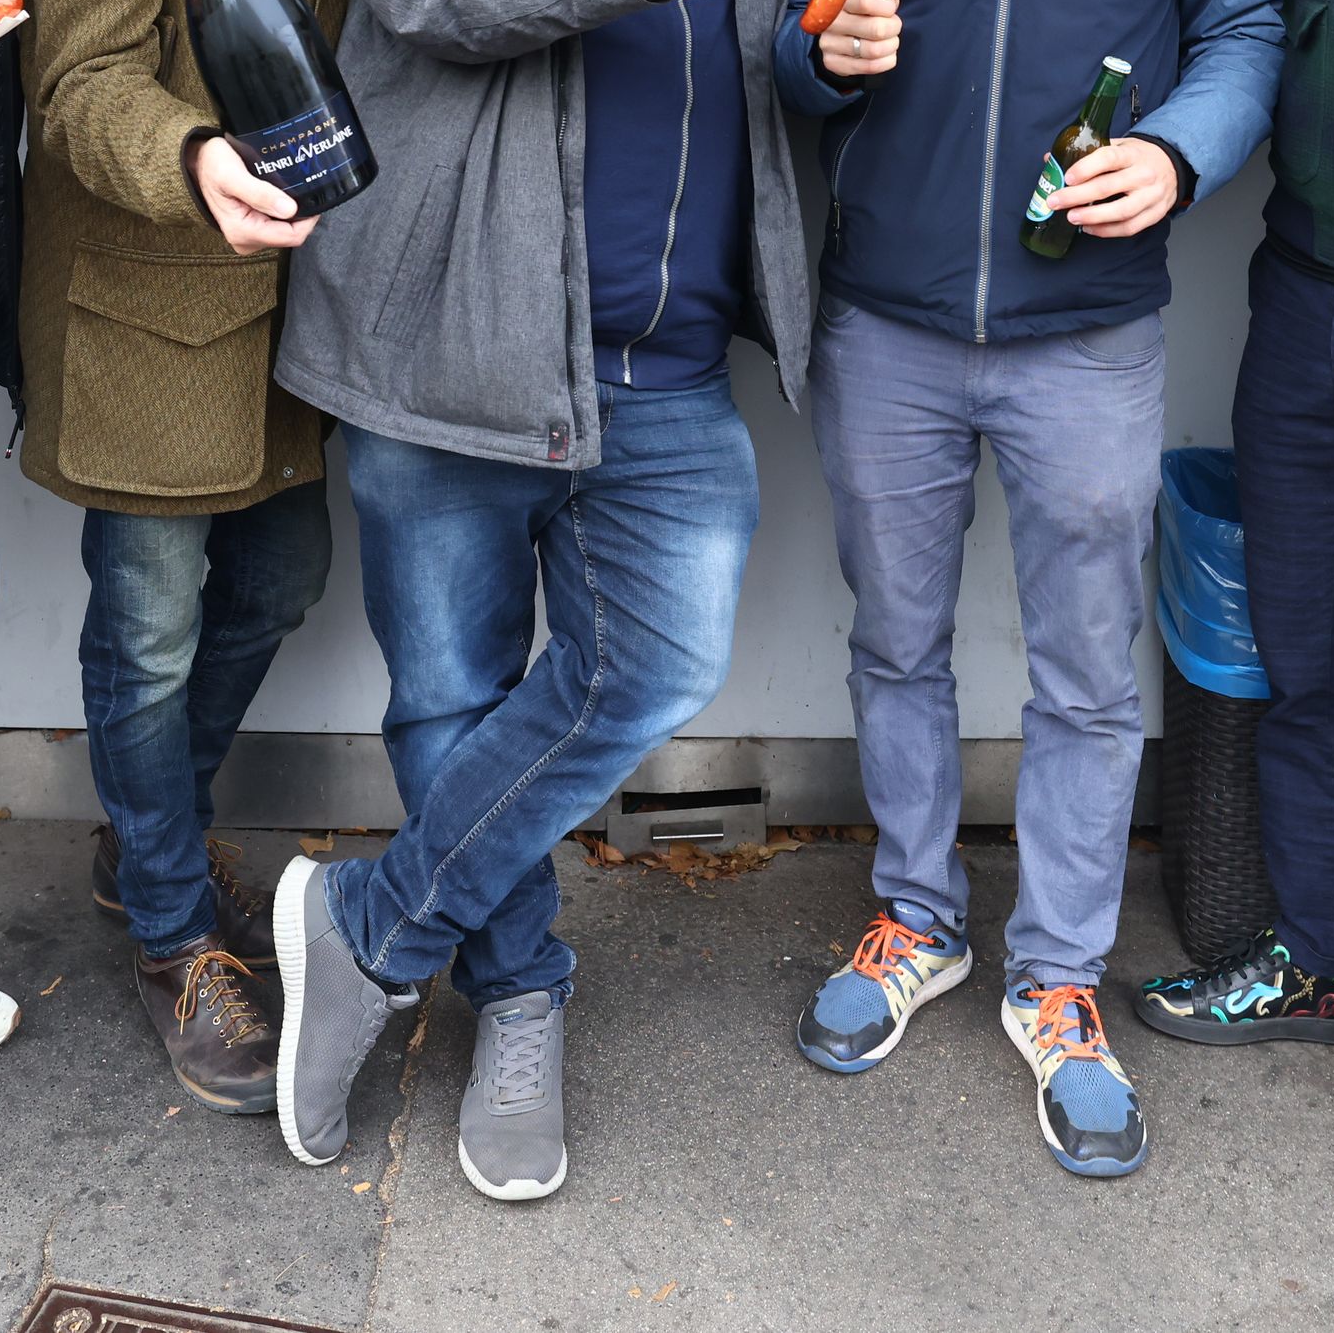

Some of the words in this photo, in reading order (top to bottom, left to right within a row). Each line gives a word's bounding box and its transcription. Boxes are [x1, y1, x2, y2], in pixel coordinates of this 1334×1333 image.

[261, 116, 337, 154] CHAMPAGNE
[254, 155, 294, 175] HENRI
[305, 169, 328, 183] BRUT
